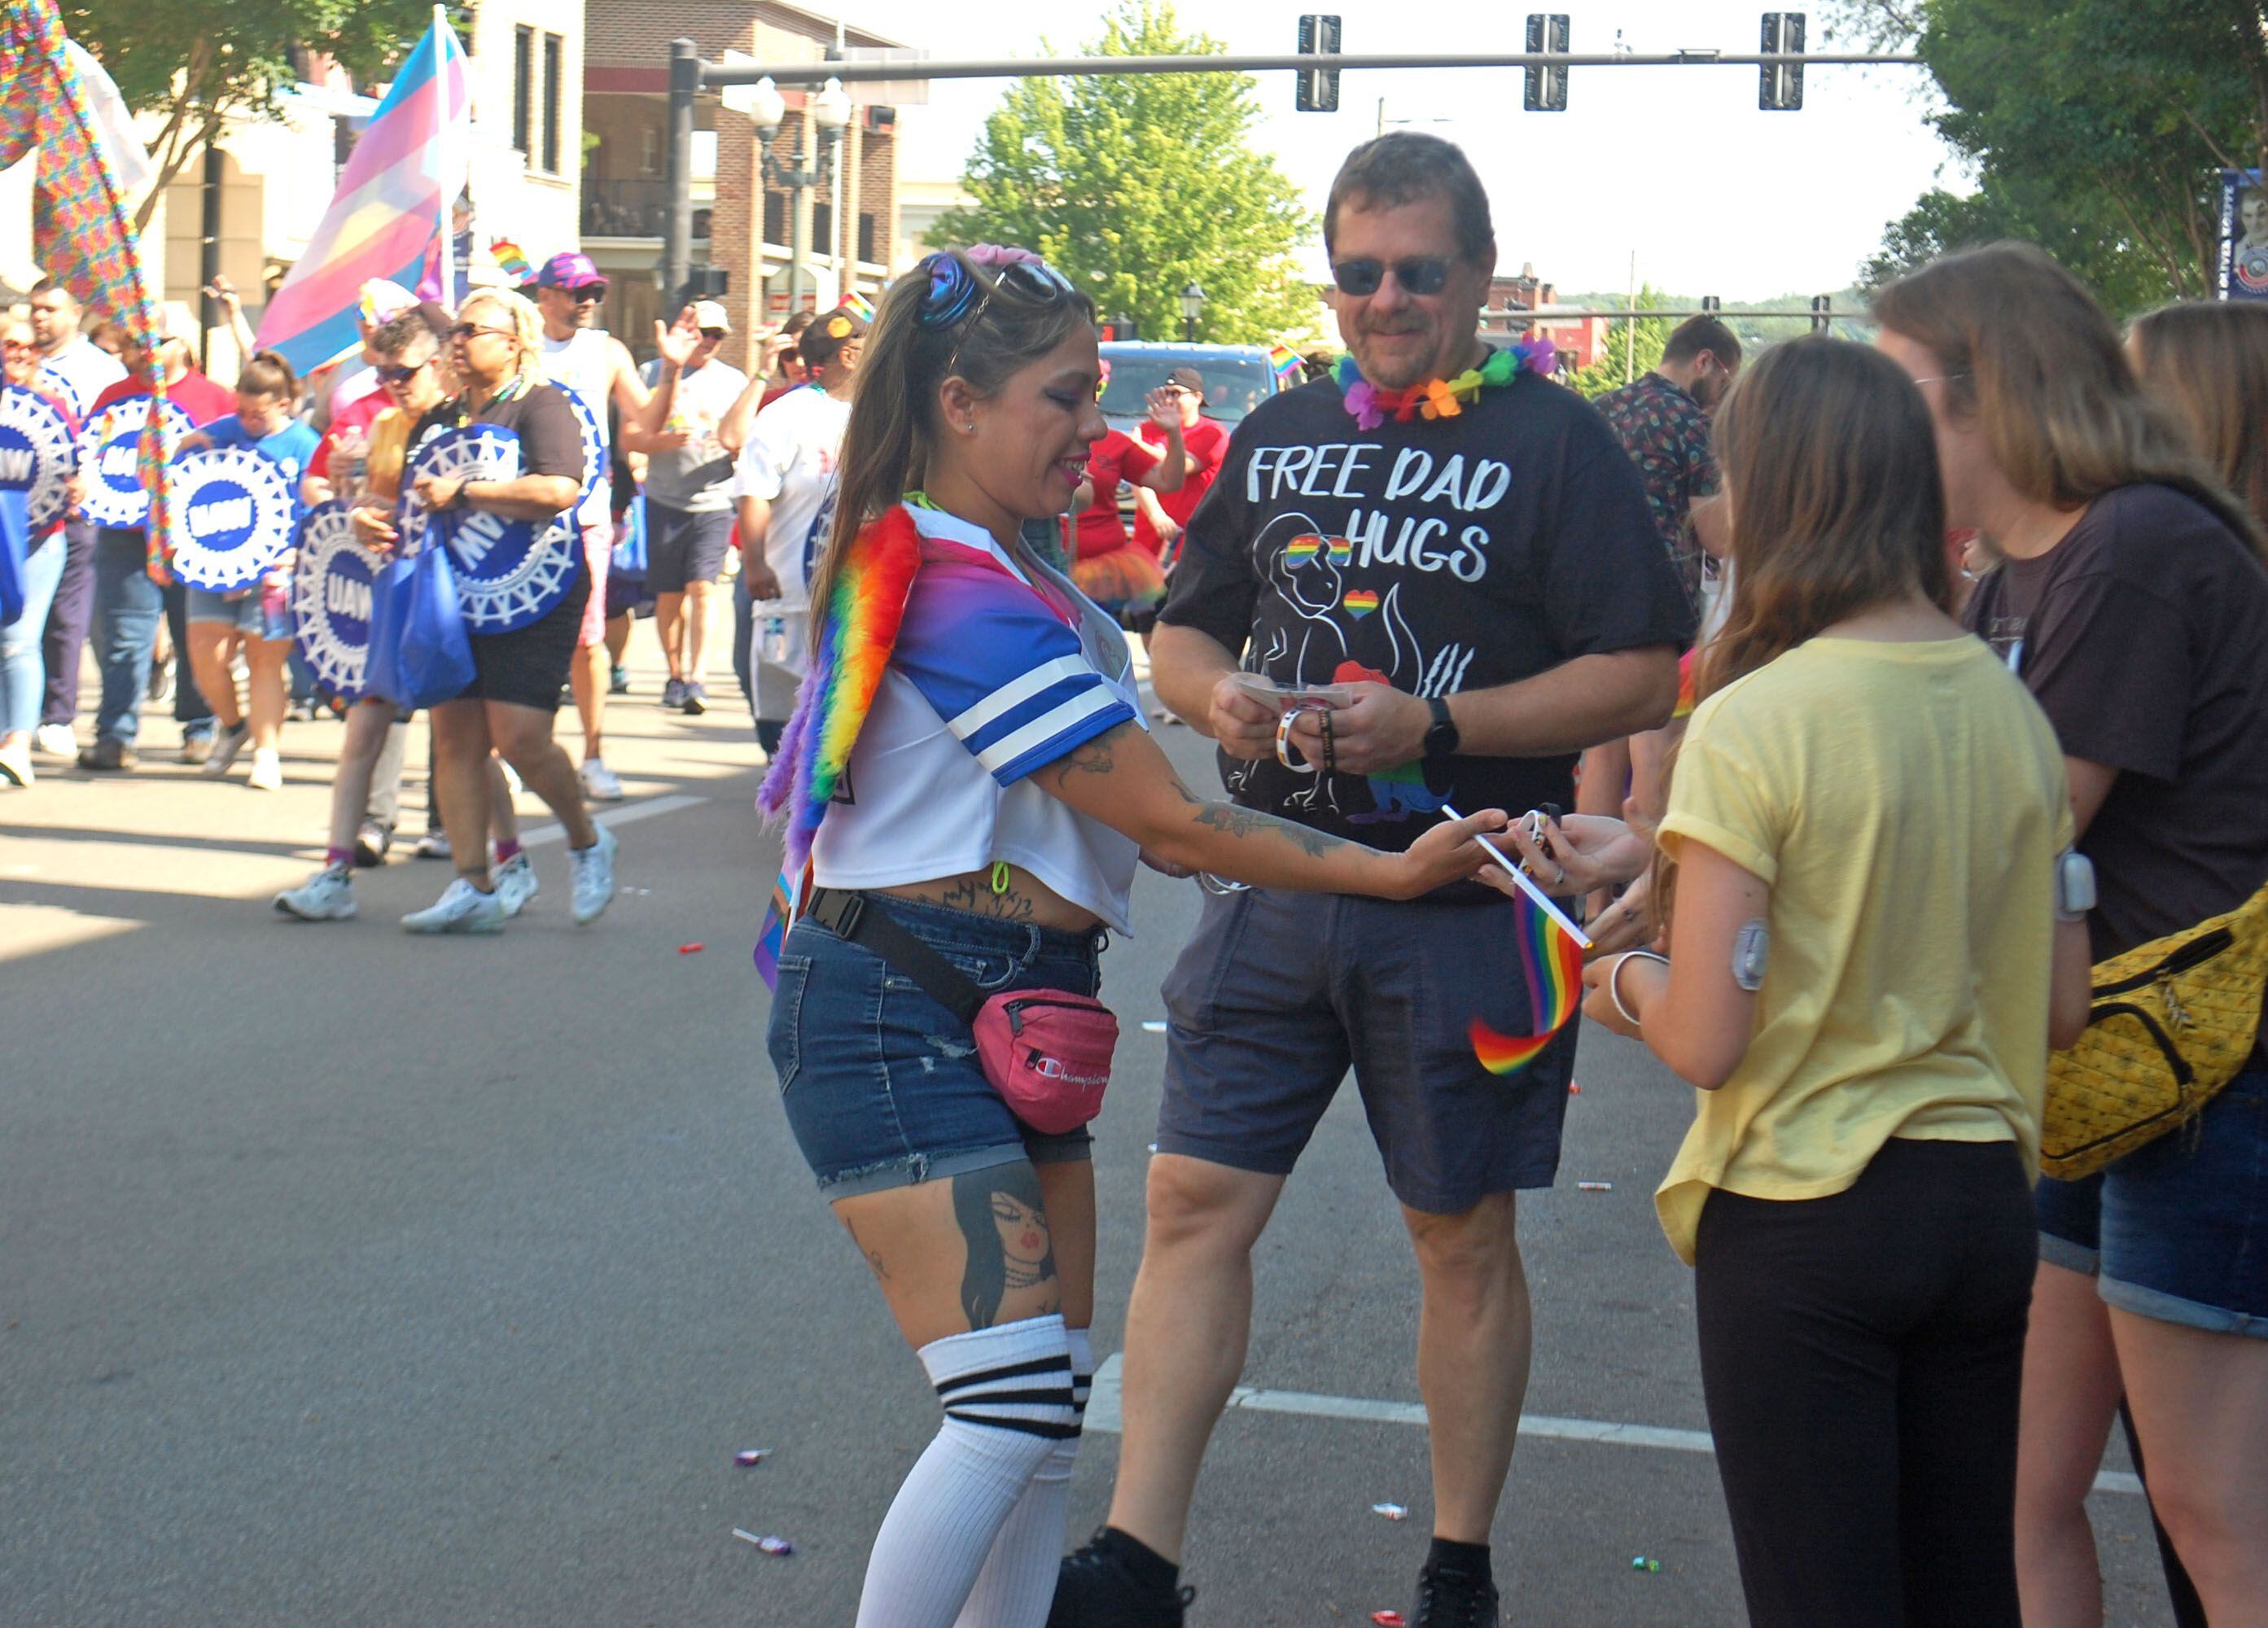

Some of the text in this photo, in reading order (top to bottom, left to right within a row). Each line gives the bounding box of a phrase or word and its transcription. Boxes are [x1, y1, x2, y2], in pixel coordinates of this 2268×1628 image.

[1247, 443, 1512, 512] FREE DAD
[187, 495, 252, 538] UAW
[450, 510, 514, 571] AW
[1344, 508, 1491, 582] HUGS
[1035, 1057, 1110, 1092] Champion
